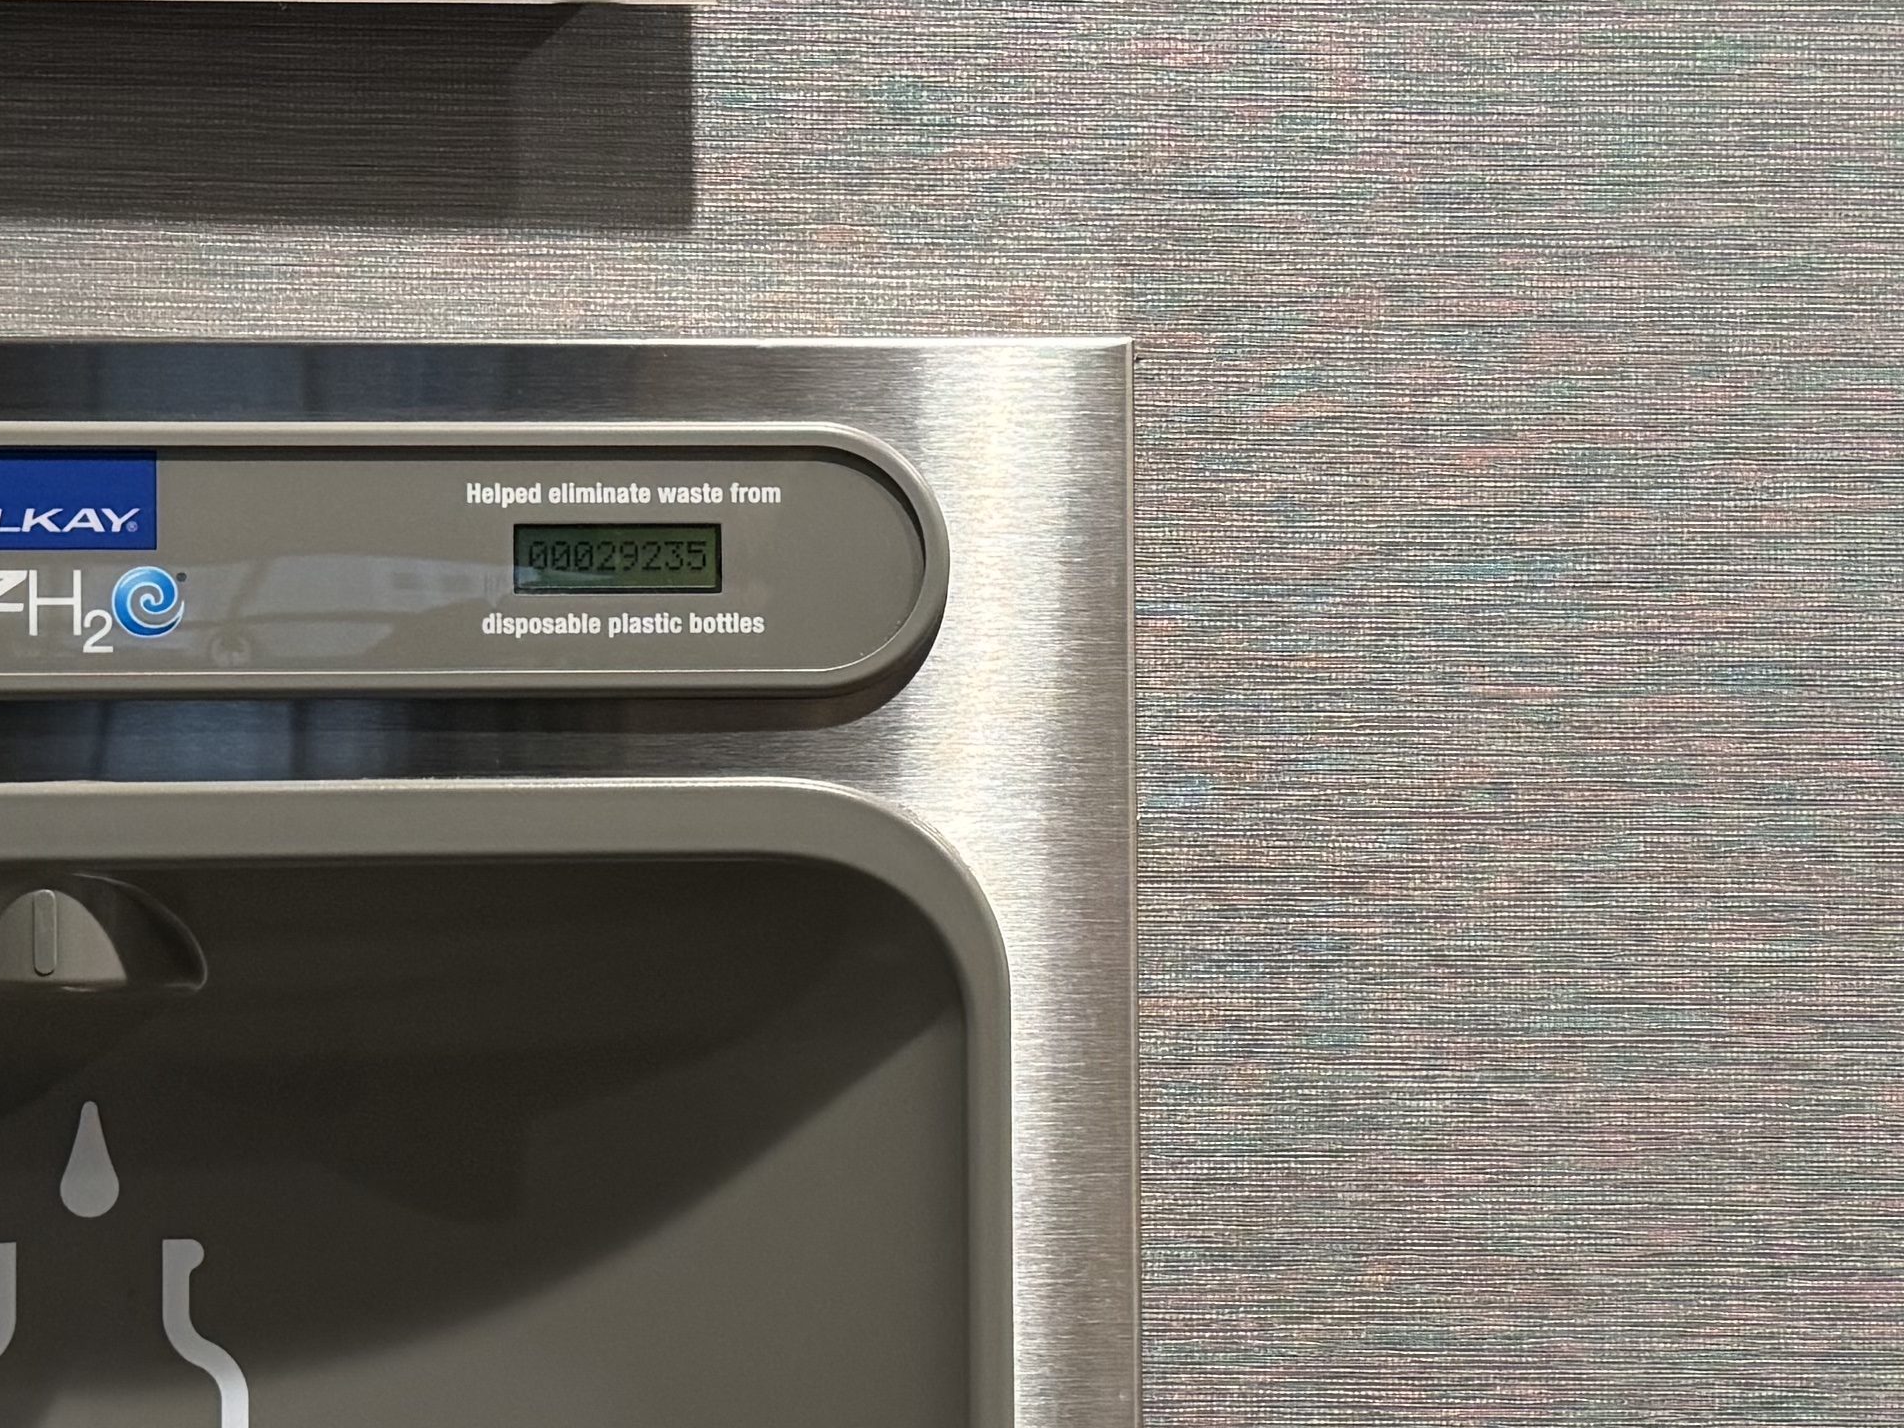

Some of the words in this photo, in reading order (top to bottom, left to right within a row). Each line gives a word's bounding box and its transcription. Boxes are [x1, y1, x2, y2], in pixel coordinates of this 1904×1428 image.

[466, 482, 543, 509] Helped
[547, 482, 652, 504] eliminate
[657, 483, 724, 504] waste
[730, 482, 782, 504] from
[528, 540, 708, 571] 00029235
[482, 612, 602, 639] disposable
[608, 612, 683, 638] plastic
[689, 612, 766, 634] bottles
